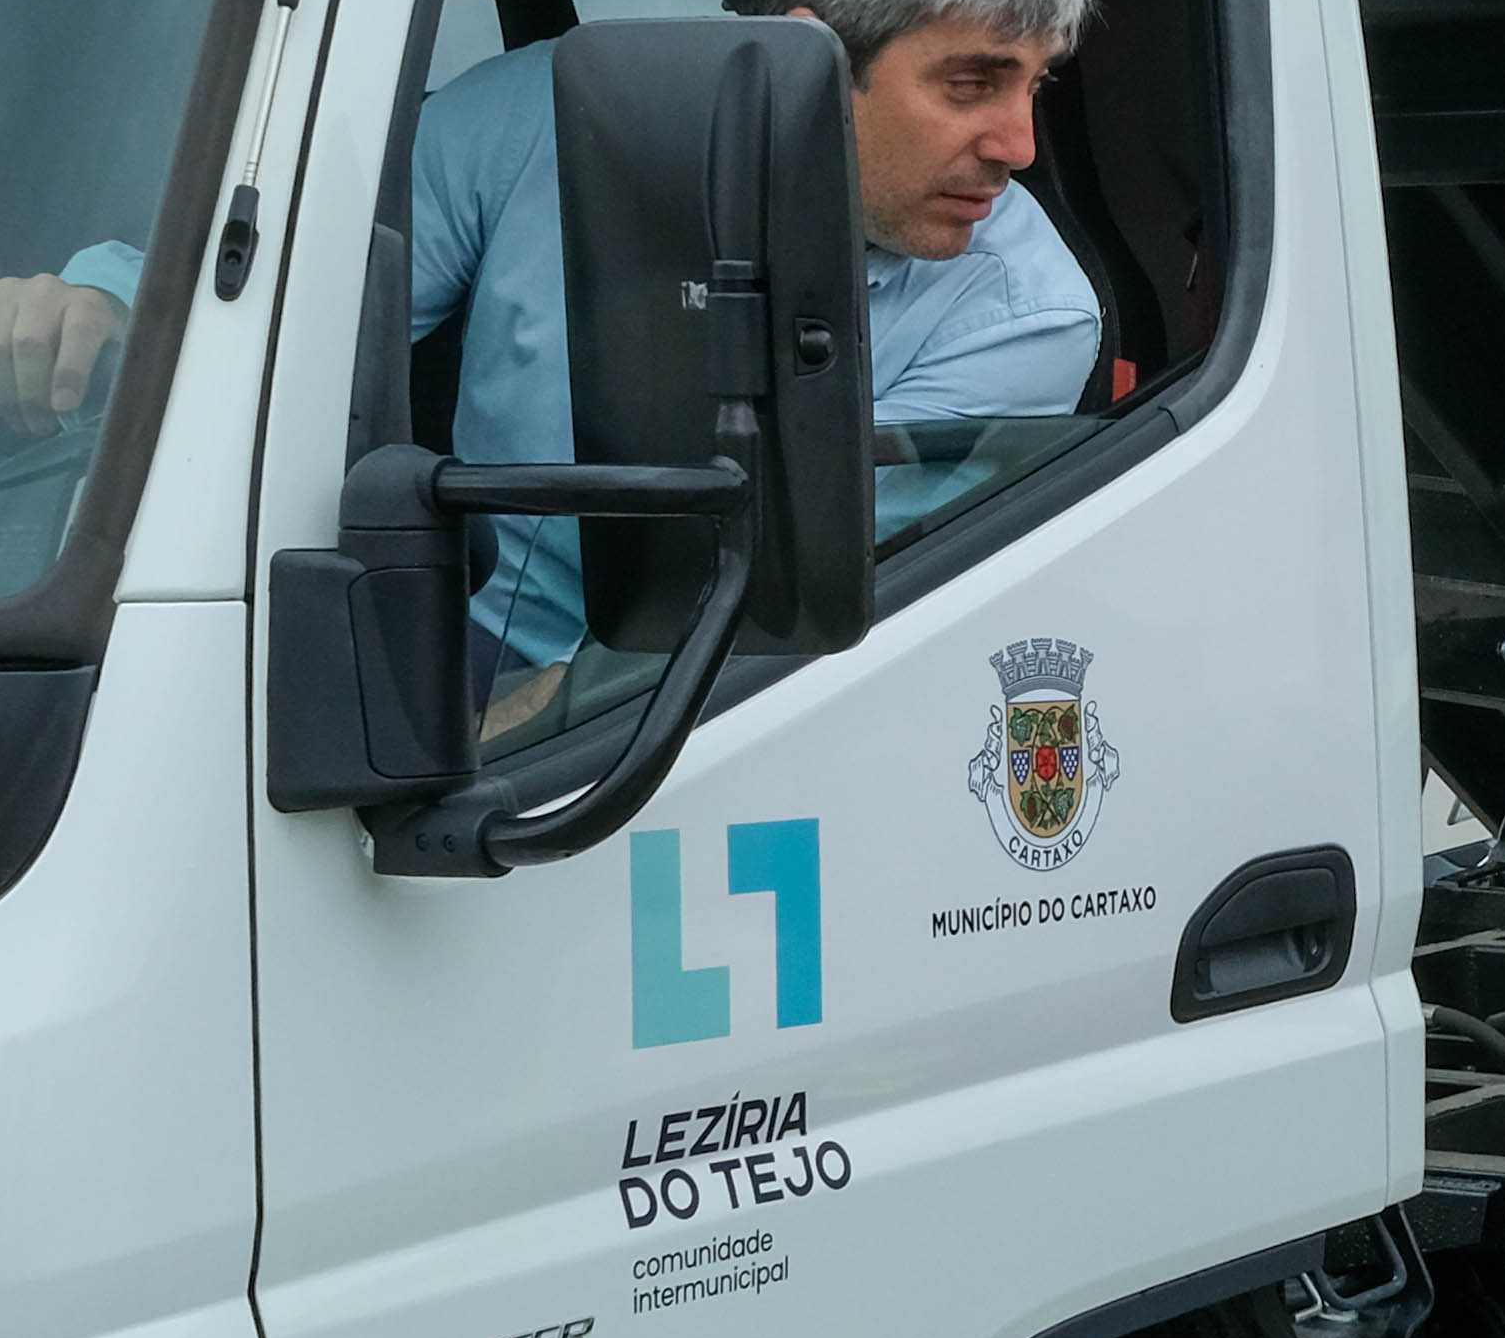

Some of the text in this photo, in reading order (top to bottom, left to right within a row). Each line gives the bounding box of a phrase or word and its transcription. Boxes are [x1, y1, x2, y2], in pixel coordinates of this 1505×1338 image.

[1008, 829, 1083, 867] CARTAXO
[932, 886, 1157, 938] MUNICÍPIO DO CARTAXO
[622, 1090, 807, 1169] LEZÍRIA
[619, 1141, 851, 1229] DO TEJO
[633, 1229, 773, 1279] comunidade
[633, 1256, 789, 1313] intermunicipal
